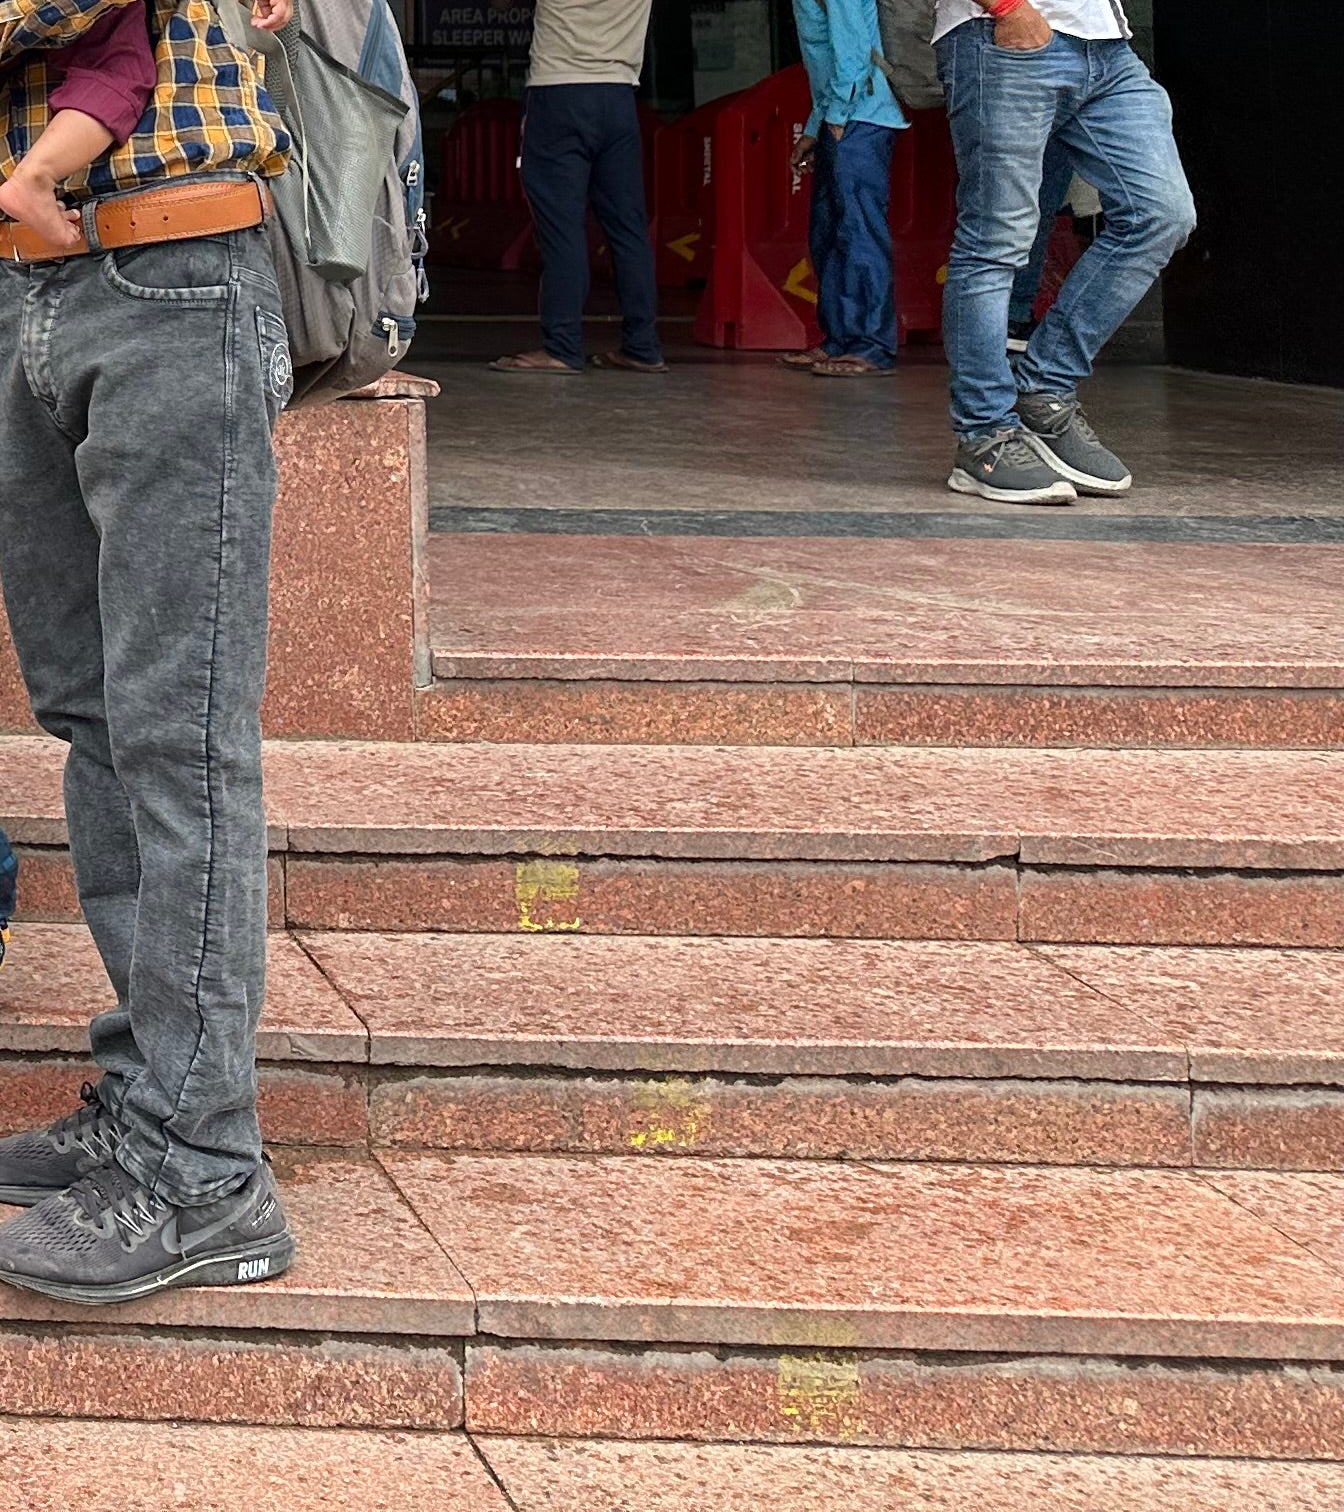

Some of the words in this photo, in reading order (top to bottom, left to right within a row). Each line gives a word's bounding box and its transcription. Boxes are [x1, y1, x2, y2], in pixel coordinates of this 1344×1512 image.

[440, 8, 483, 24] AREA
[487, 8, 534, 24] PROP
[431, 29, 506, 46] SLEEPER
[508, 29, 533, 45] WA
[236, 1258, 270, 1280] RUN
